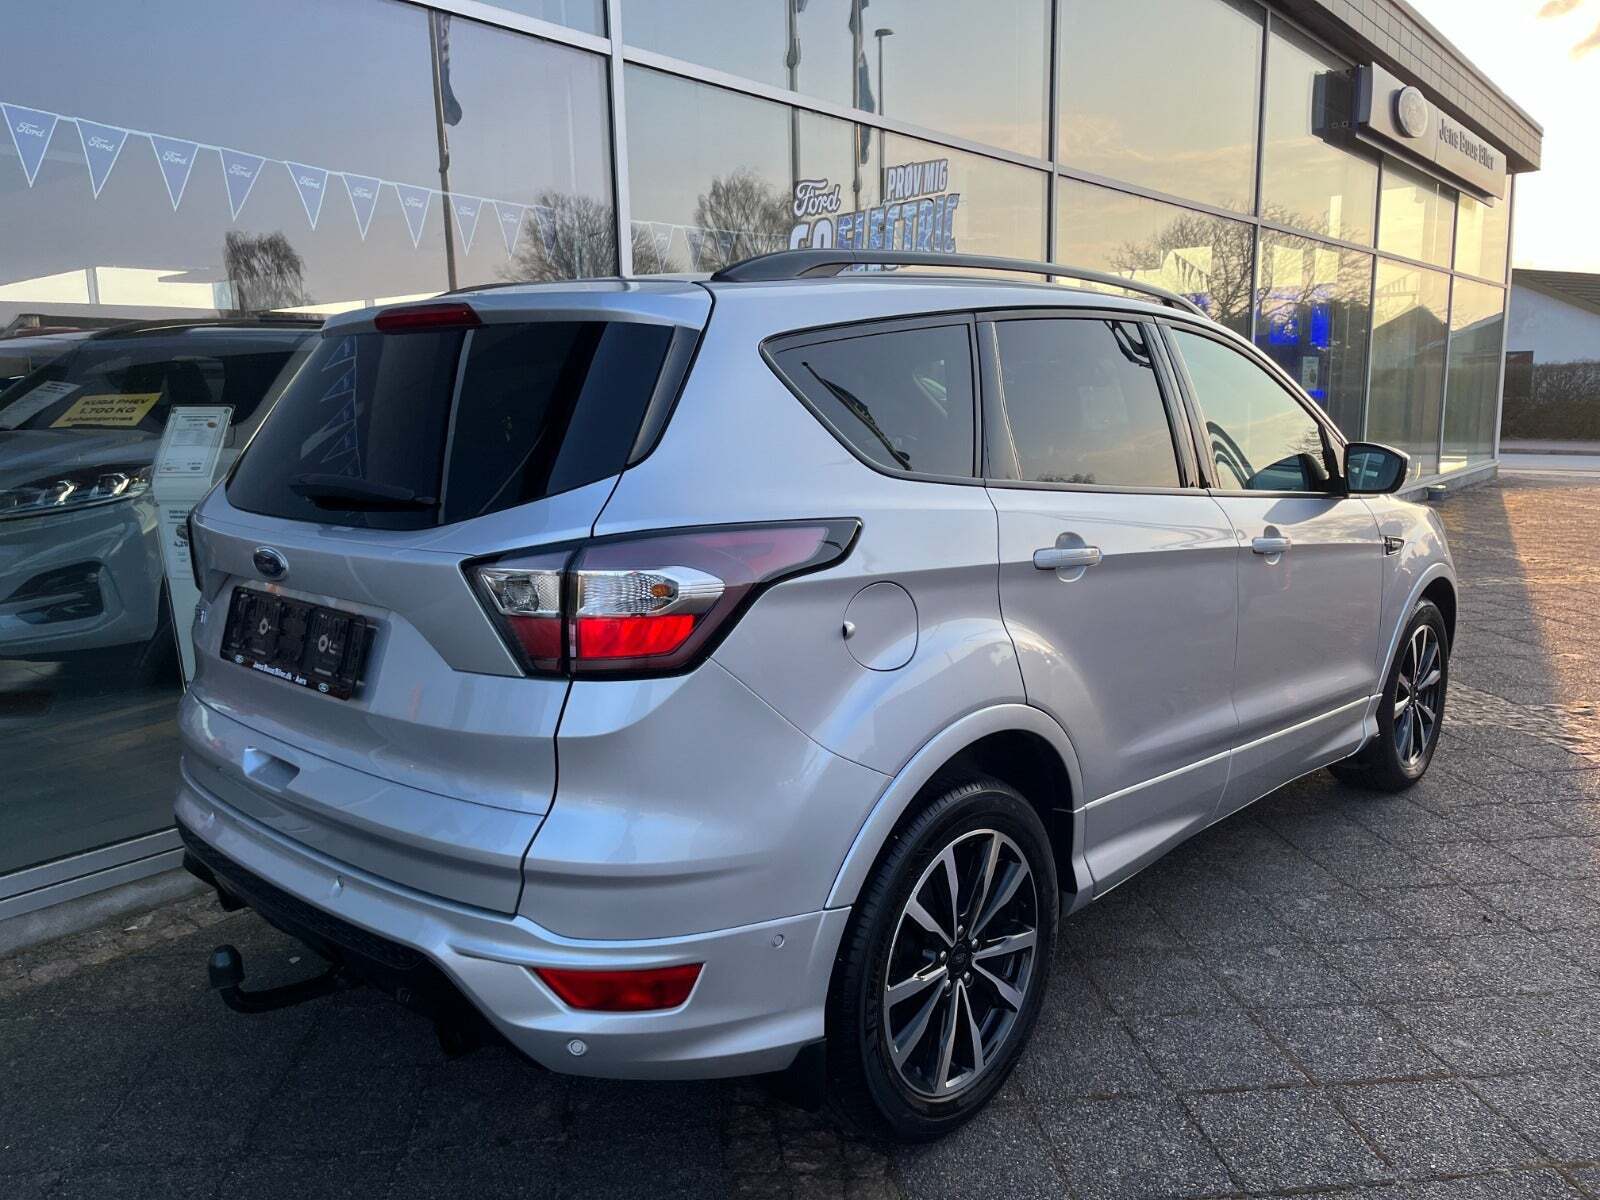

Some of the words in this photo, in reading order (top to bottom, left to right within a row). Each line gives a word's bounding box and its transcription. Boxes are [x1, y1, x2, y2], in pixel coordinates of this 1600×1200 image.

[16, 121, 46, 138] Ford
[88, 136, 115, 152] Ford
[162, 151, 187, 166] Ford
[229, 163, 252, 179] Ford
[887, 162, 922, 200] PRØV
[922, 158, 948, 194] MIG
[299, 175, 321, 190] Ford
[352, 186, 374, 200] Ford
[793, 178, 841, 217] Ford
